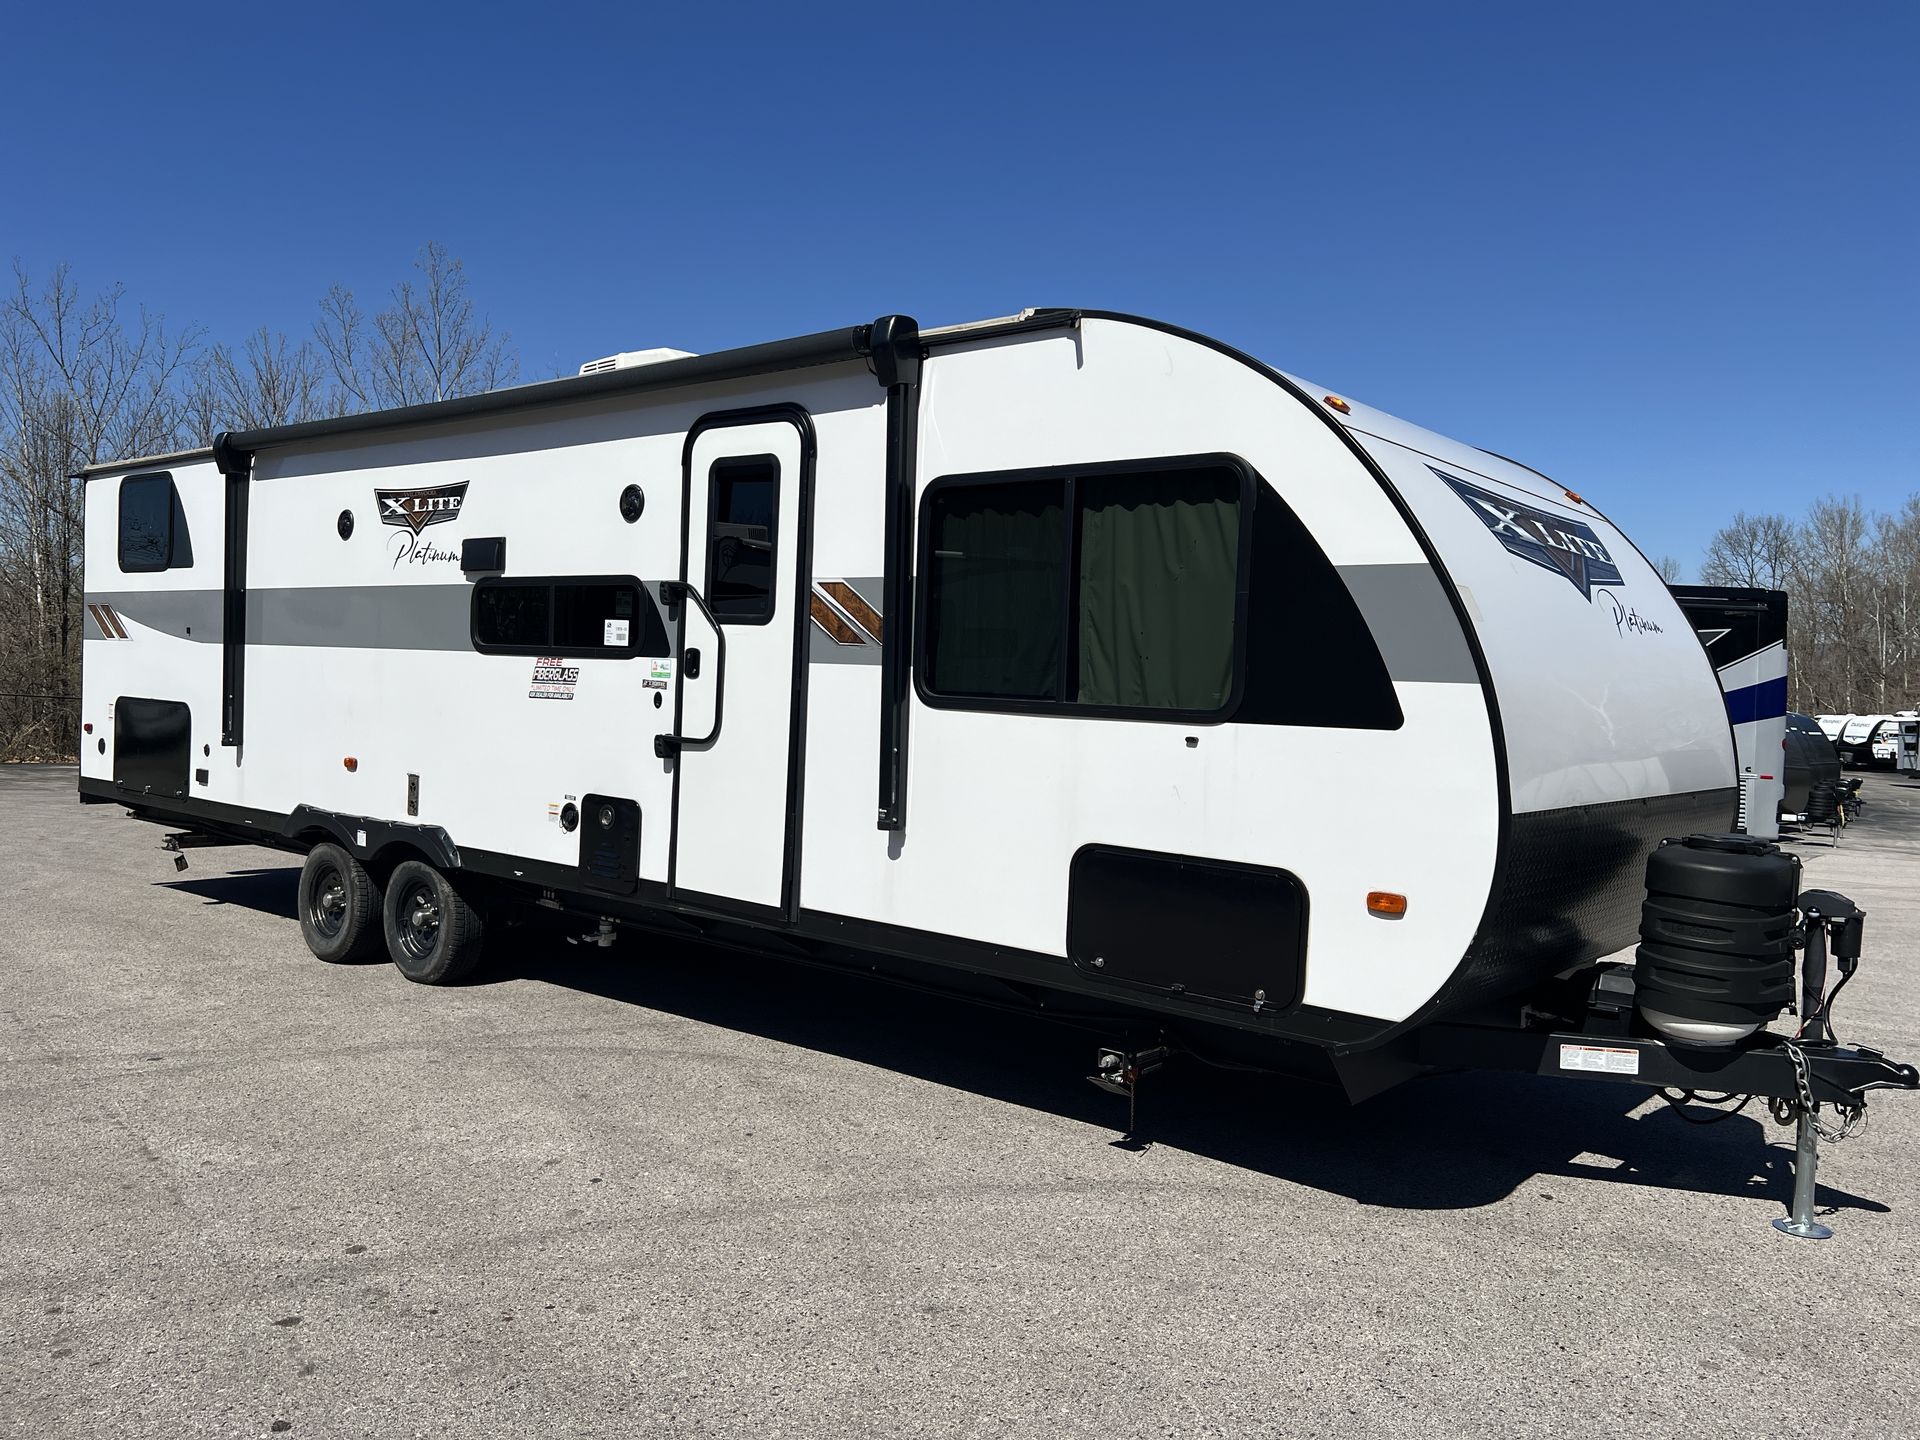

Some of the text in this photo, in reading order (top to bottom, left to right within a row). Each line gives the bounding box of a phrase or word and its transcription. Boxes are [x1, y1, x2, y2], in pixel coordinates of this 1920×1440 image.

[387, 529, 462, 571] Platinum
[1596, 588, 1663, 639] Platinum
[533, 668, 579, 681] FIBERGLASS
[535, 656, 563, 666] FREE
